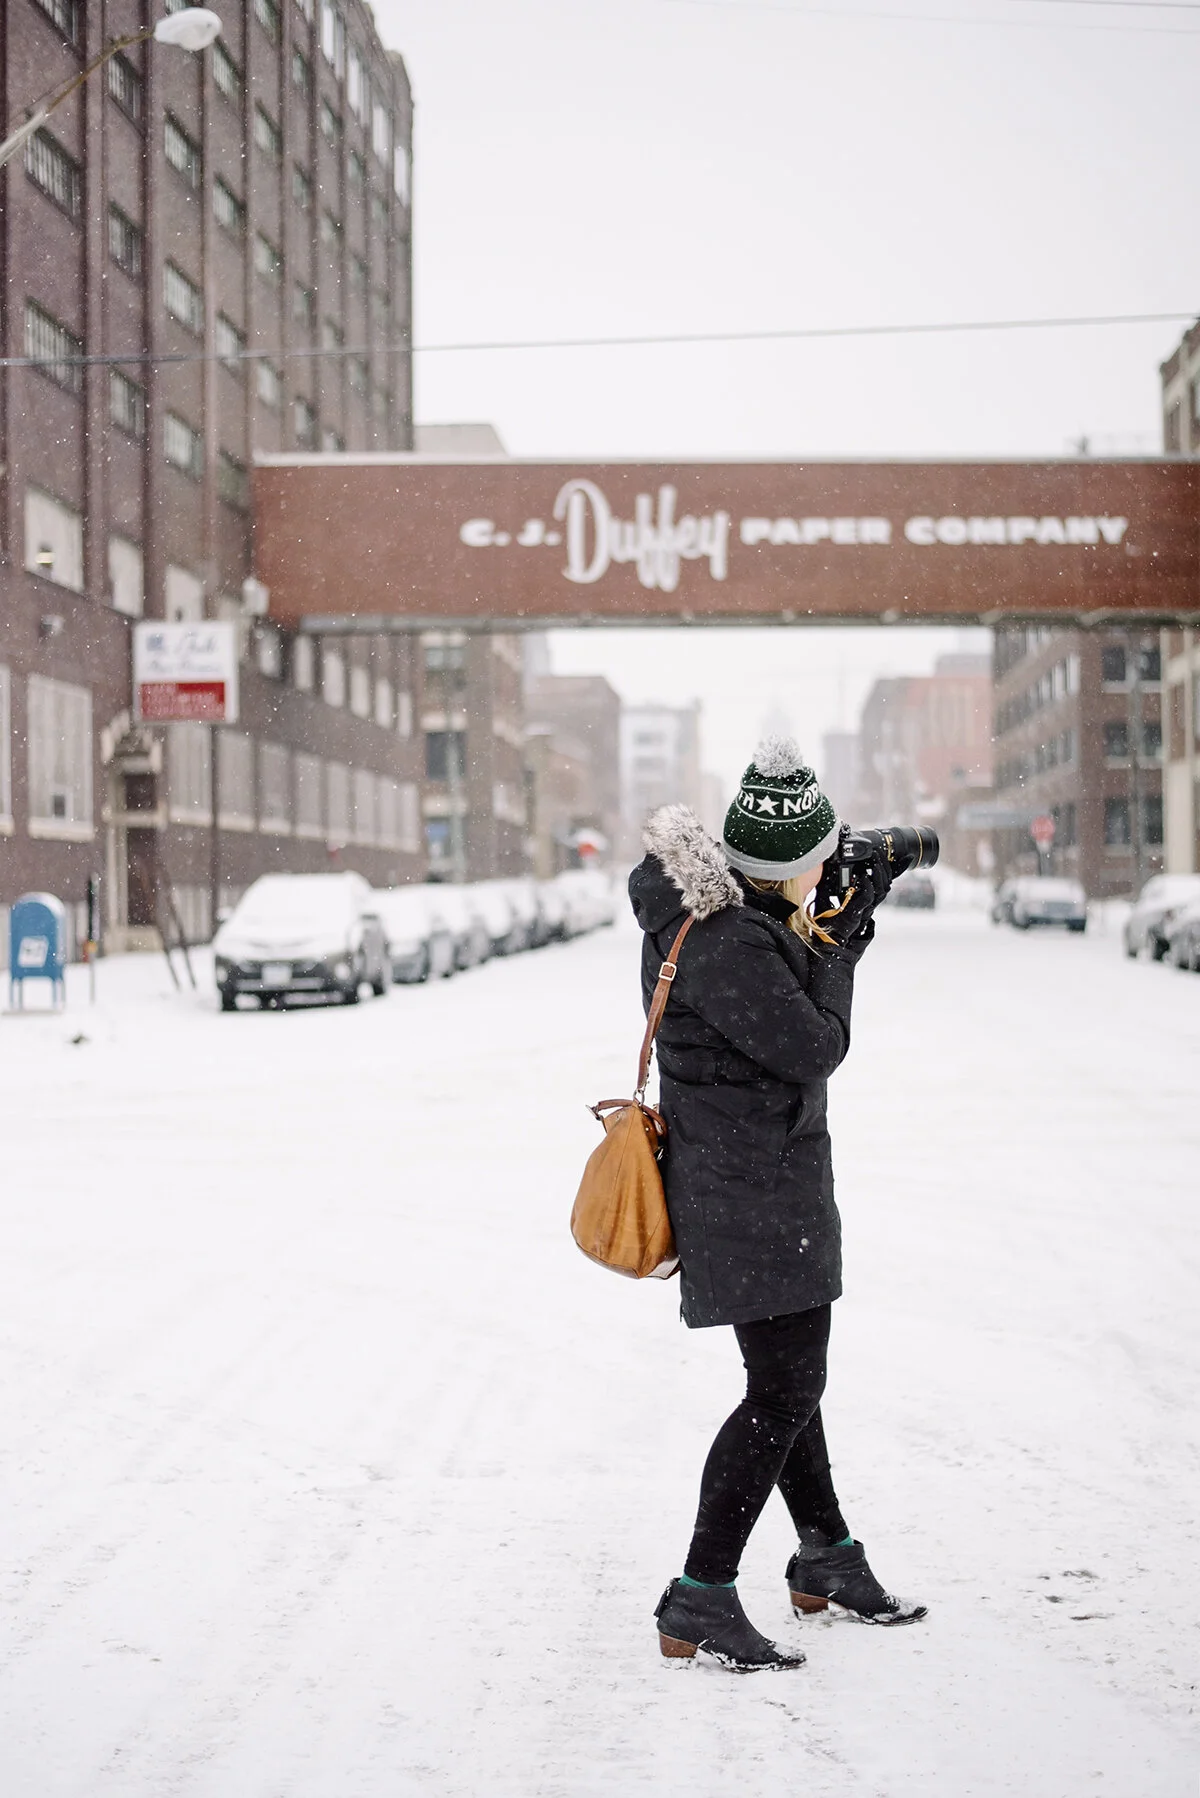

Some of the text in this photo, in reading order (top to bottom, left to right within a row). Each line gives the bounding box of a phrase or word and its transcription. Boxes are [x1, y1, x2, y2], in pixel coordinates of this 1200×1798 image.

[553, 479, 728, 592] Duffey
[741, 517, 891, 544] PAPER
[904, 517, 1128, 544] COMPANY
